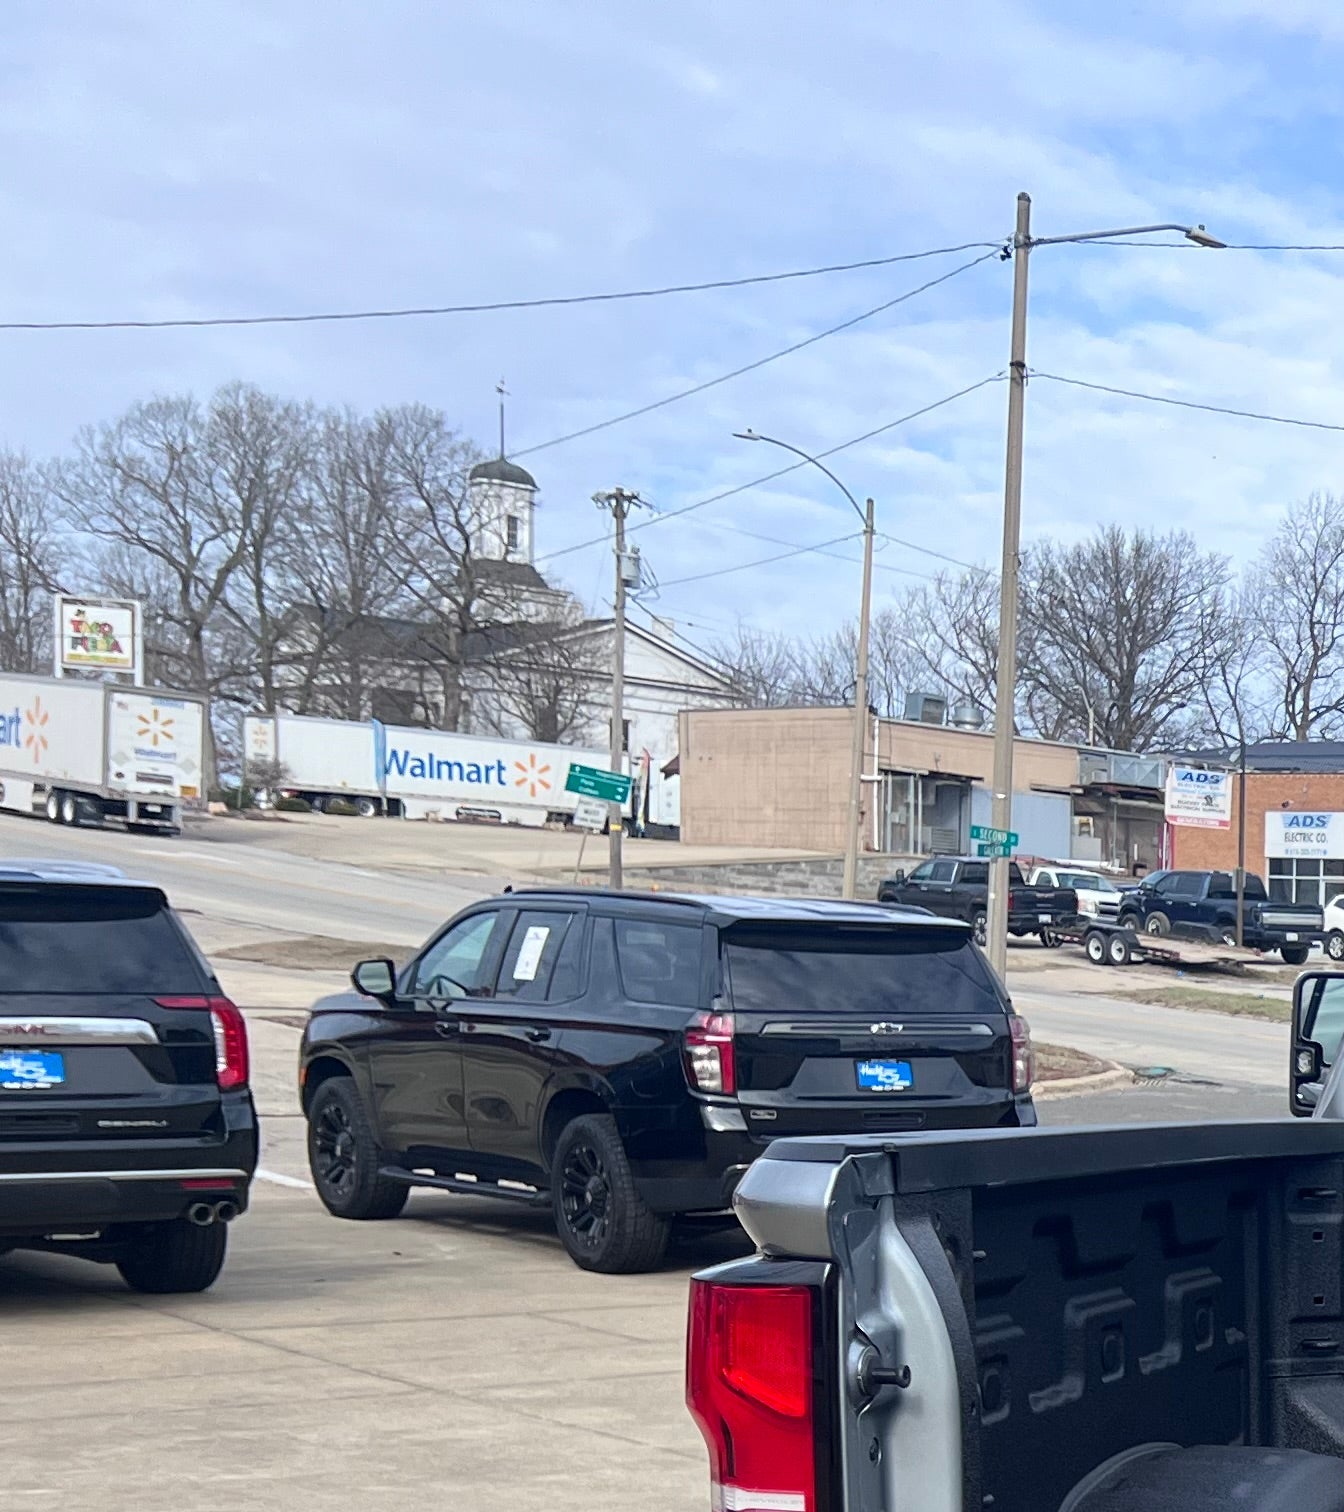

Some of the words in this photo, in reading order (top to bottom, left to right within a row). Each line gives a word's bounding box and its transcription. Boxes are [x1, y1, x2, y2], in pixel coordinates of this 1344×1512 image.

[70, 619, 113, 635] TACO
[384, 748, 507, 786] Walmart
[1181, 772, 1221, 785] ADS
[1288, 815, 1328, 828] ADS
[979, 828, 1008, 843] SECOND
[1284, 832, 1314, 843] ELECTRIC
